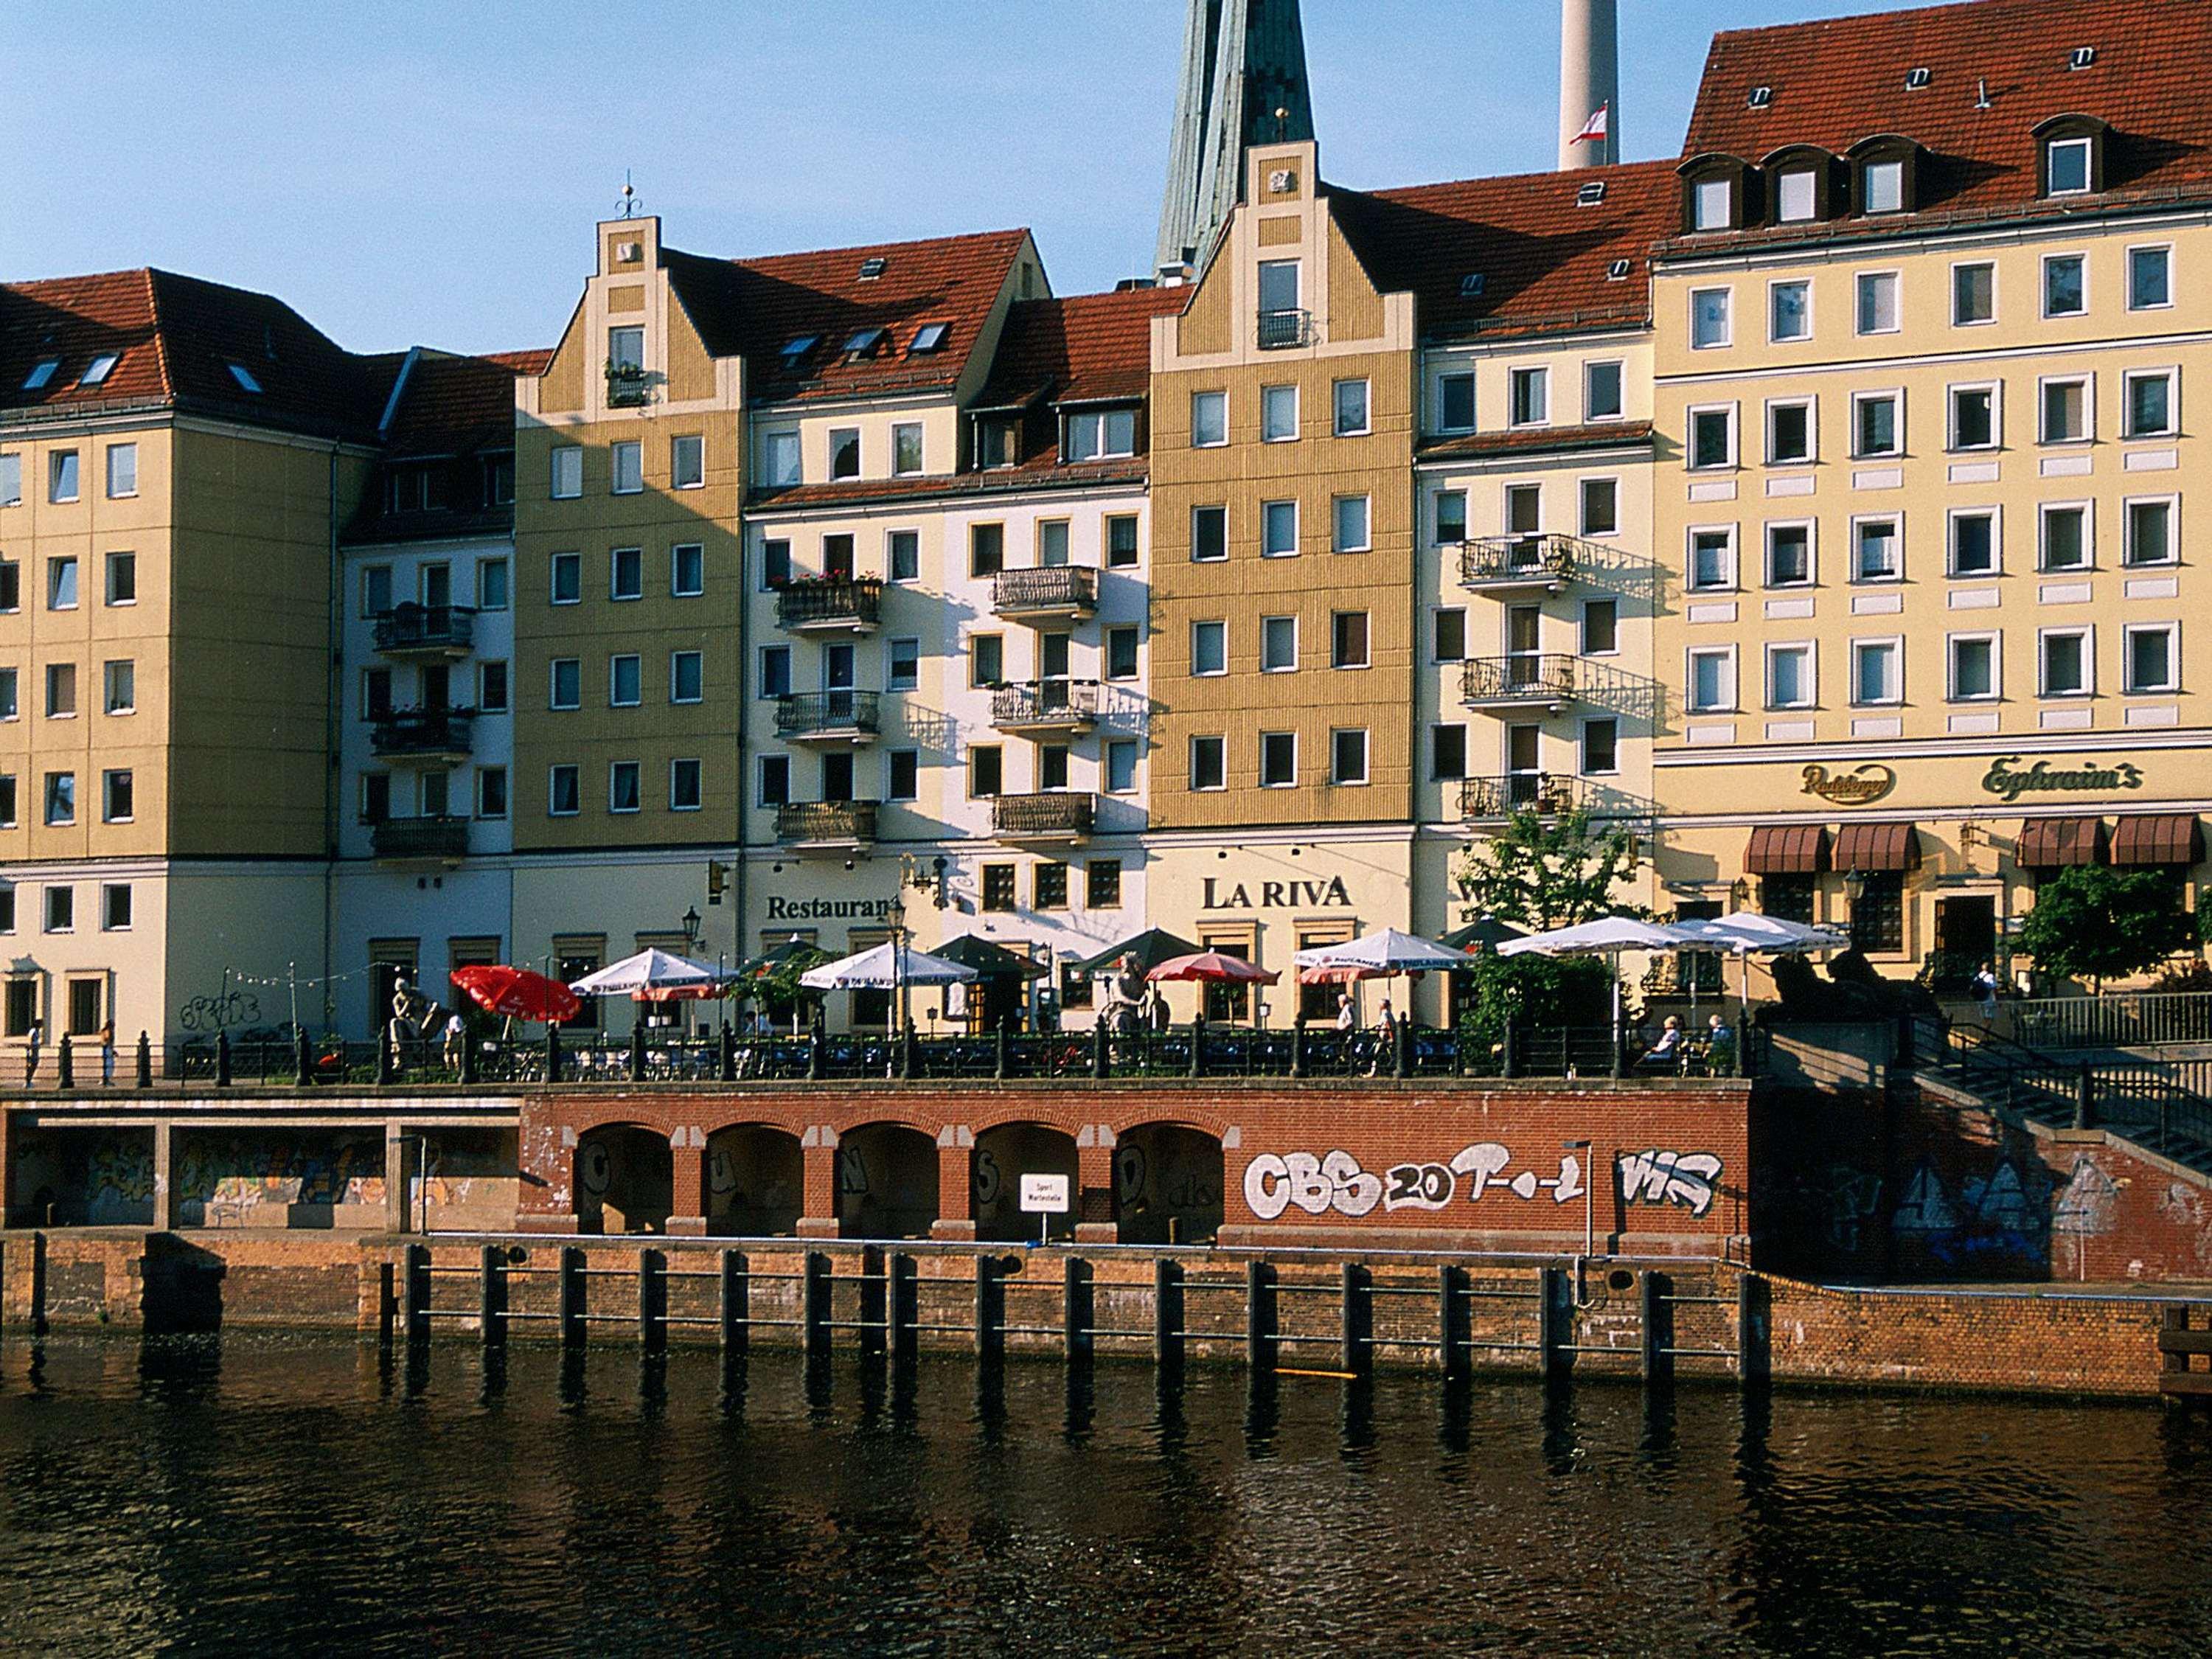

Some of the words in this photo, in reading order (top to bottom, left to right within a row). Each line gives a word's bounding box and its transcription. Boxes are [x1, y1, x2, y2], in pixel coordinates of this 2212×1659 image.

[1981, 756, 2145, 802] Ephraim's
[768, 895, 894, 919] Restauran
[1201, 877, 1253, 909] LA
[1262, 874, 1354, 908] RIVA
[1242, 1149, 1382, 1220] CBS
